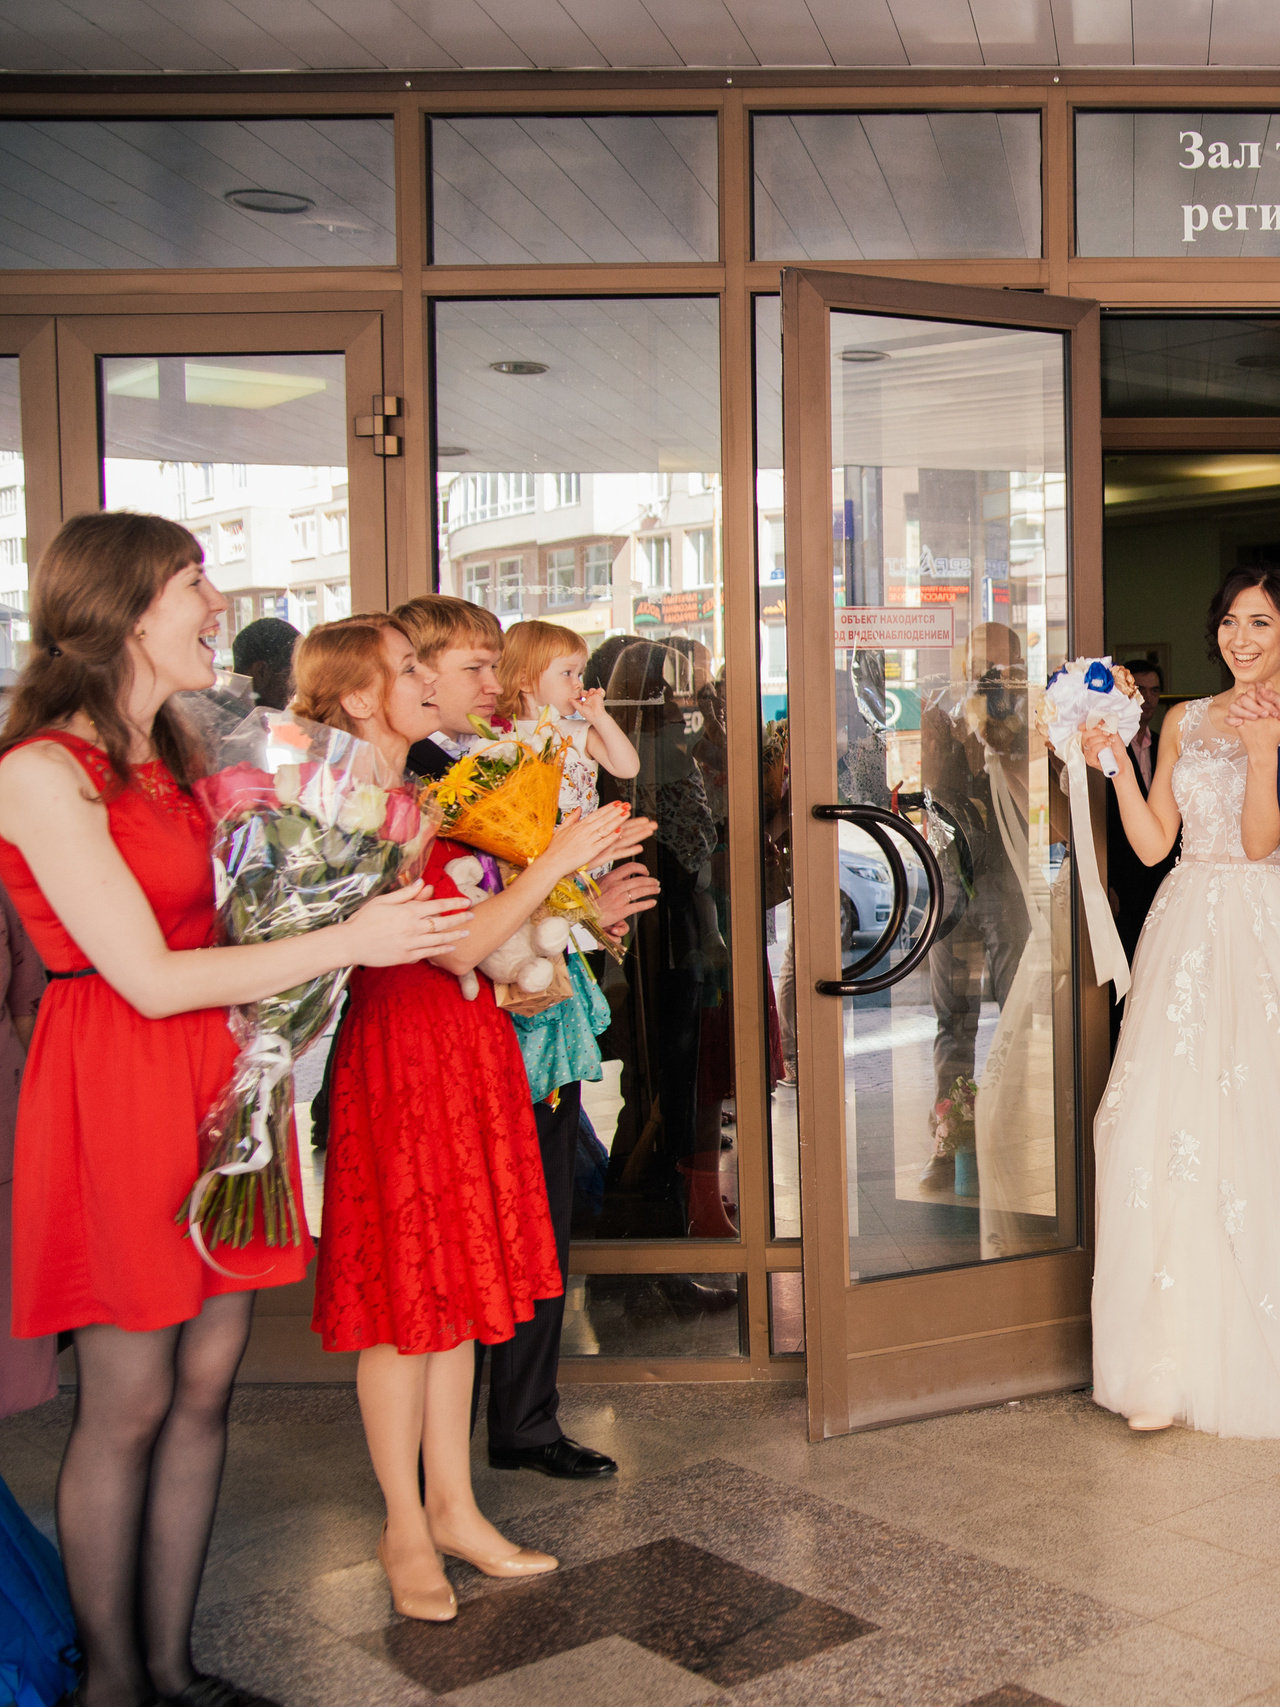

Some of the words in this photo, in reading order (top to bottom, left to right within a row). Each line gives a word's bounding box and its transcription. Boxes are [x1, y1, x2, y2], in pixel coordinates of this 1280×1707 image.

[1178, 131, 1261, 169] Зал
[840, 614, 877, 624] ОБЪЕКТ
[880, 614, 935, 625] НАХОДИТСЯ
[834, 630, 846, 642] ОД
[848, 630, 950, 642] ВИДЕОНАБЛЮДЕНИЕМ
